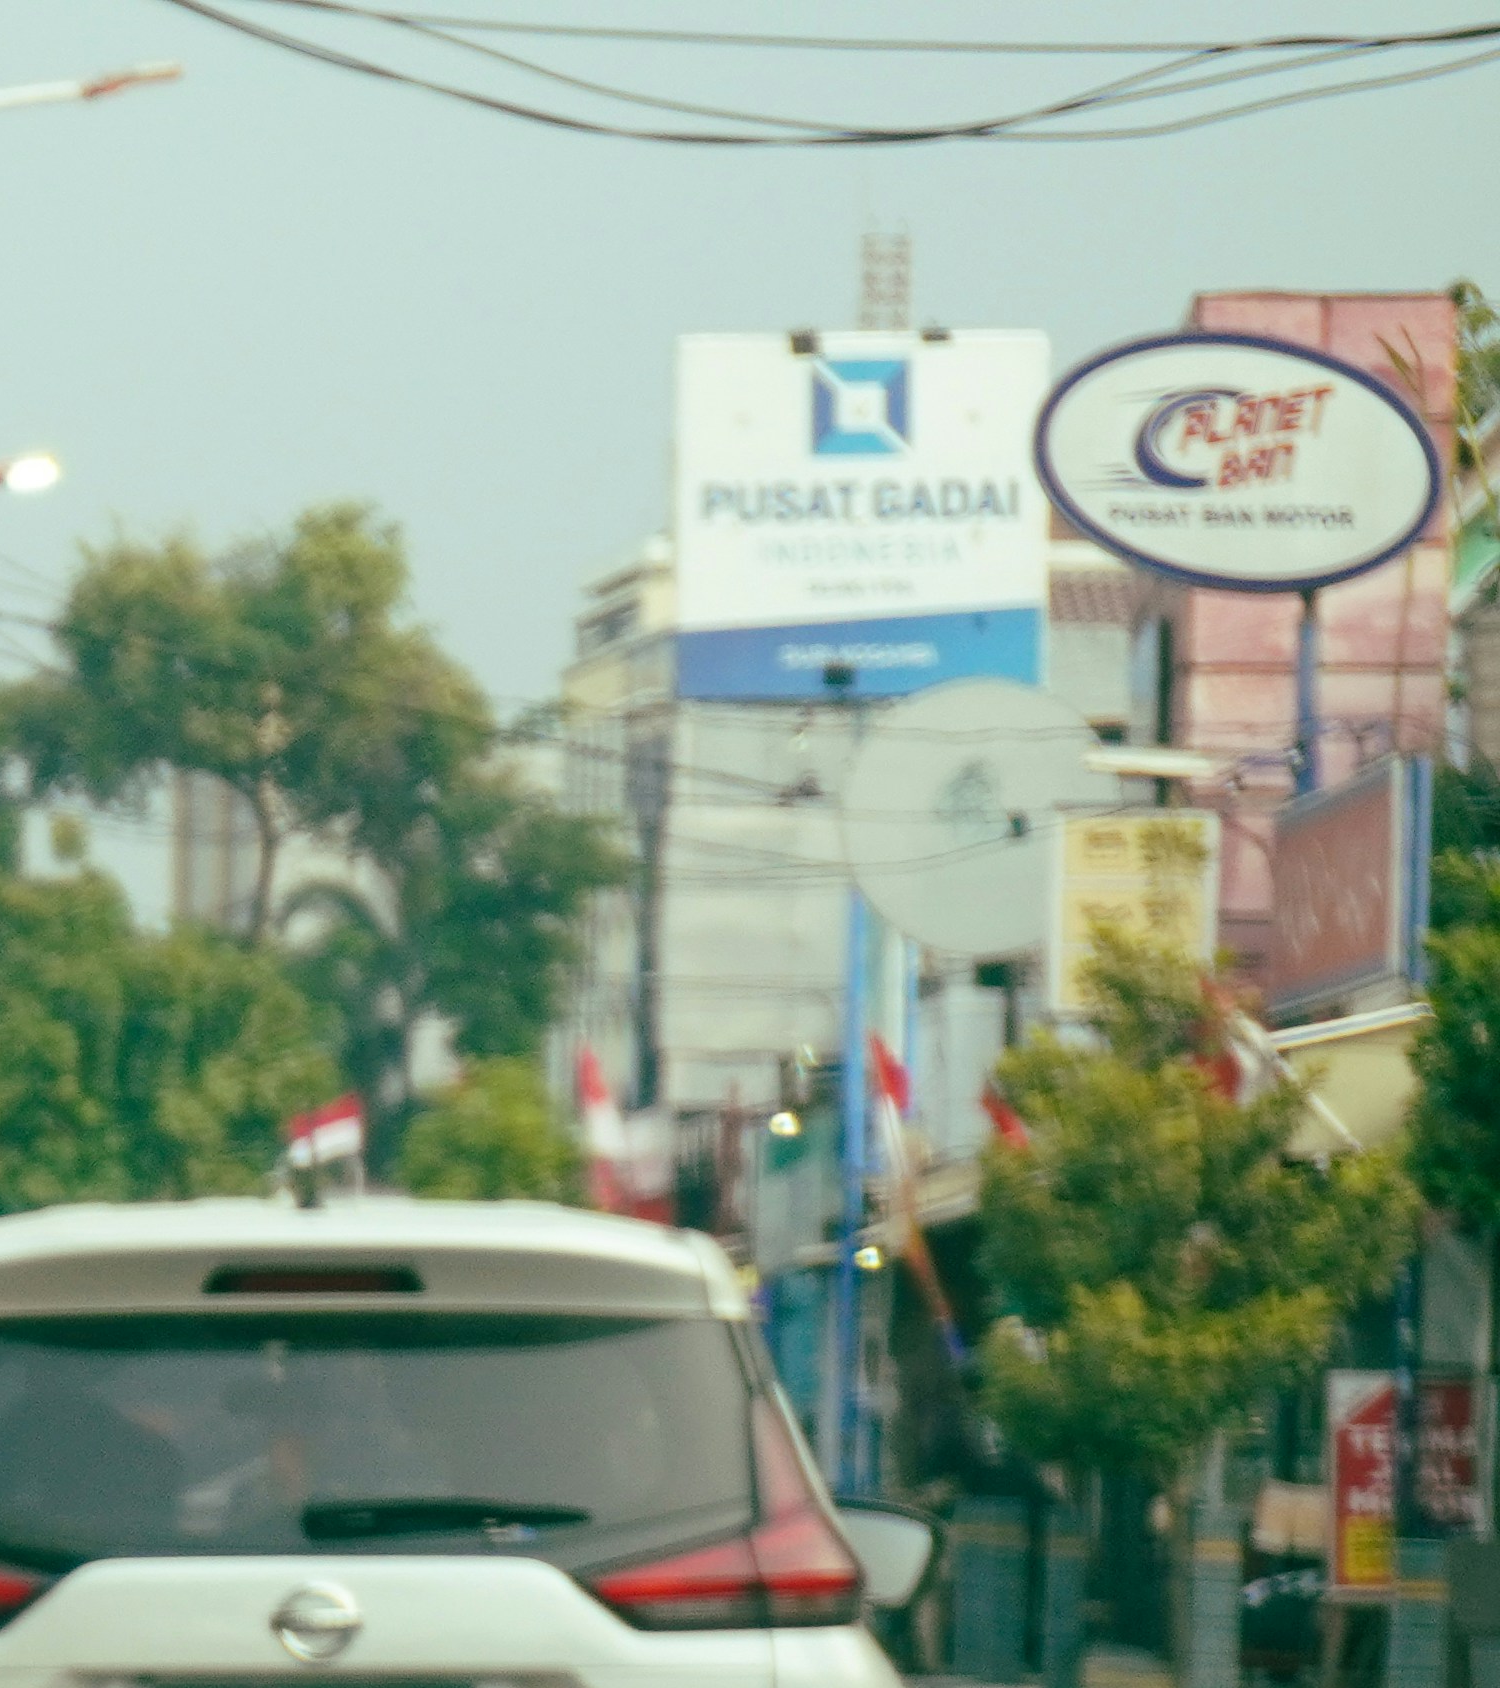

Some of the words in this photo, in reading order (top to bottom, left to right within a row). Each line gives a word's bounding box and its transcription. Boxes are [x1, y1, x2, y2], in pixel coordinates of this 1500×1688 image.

[1175, 383, 1337, 456] PLANET
[696, 478, 856, 523] PUSAT
[870, 477, 1022, 521] GADAI
